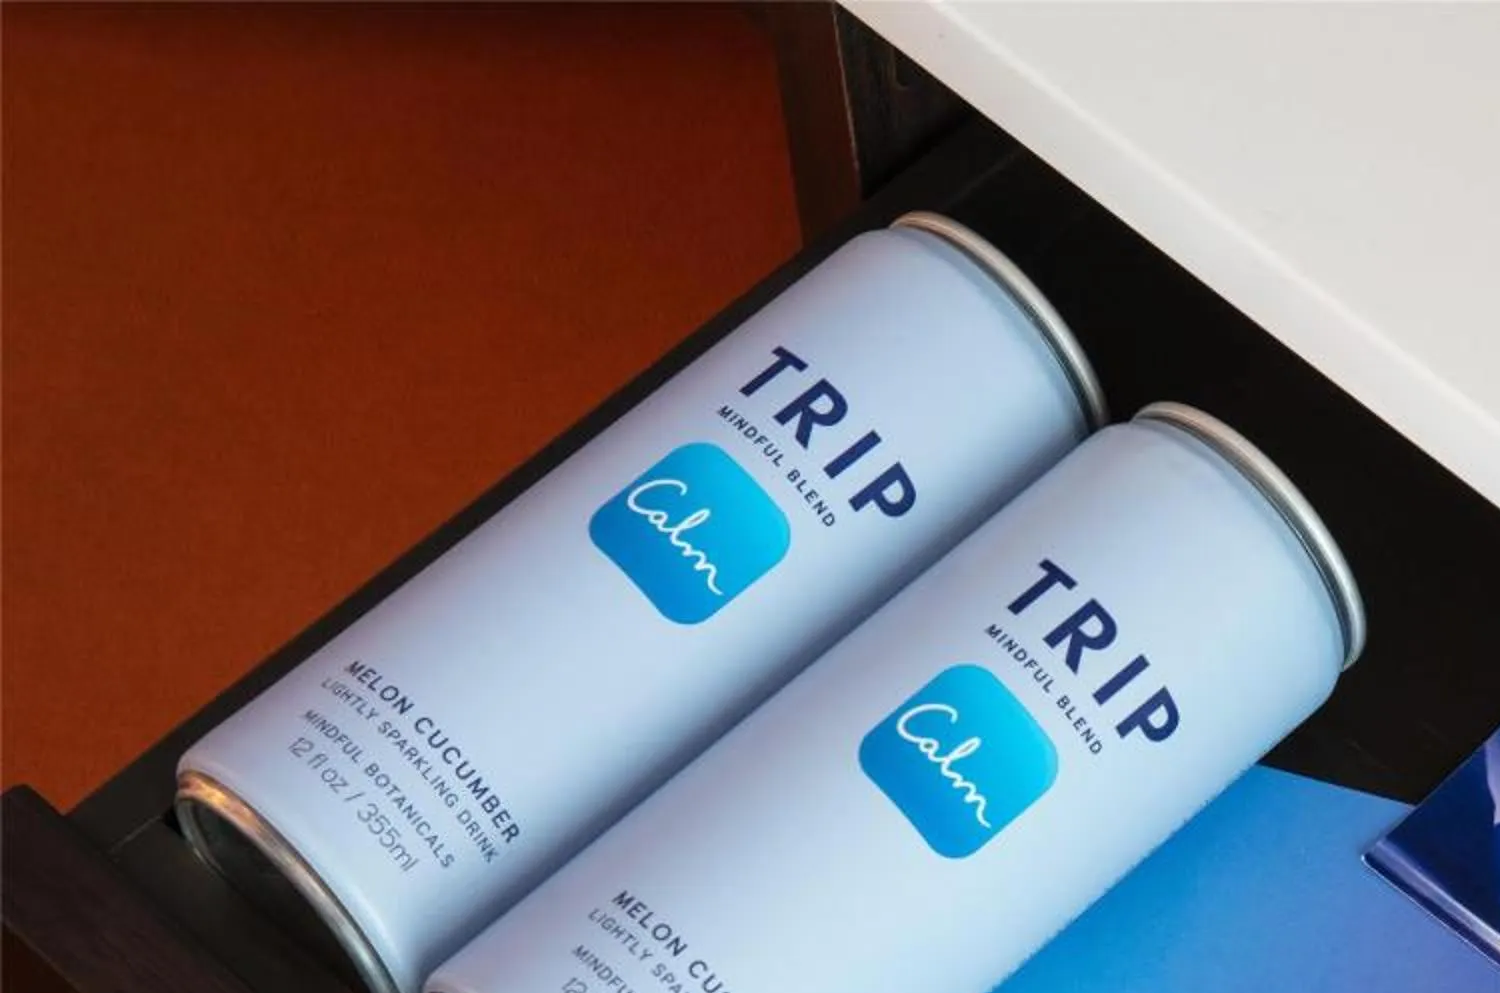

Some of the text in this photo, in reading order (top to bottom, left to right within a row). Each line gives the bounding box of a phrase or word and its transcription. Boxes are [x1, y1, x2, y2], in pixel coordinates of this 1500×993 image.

[716, 405, 836, 528] MINDFUL BLEND
[739, 345, 917, 518] TRIP
[627, 479, 724, 596] Calm
[984, 624, 1103, 755] MINDFUL BLEND
[1007, 558, 1180, 743] TRIP
[288, 737, 420, 873] 12 fl oz / 355ml
[303, 709, 455, 869] MINDFUL BOTANICALS
[321, 677, 499, 864] LIGHTLY SPARKLING DRINK
[345, 661, 520, 843] MELON CUCUMBER
[896, 703, 992, 829] Calm
[588, 907, 653, 962] LIGHTLY
[611, 890, 688, 957] MELON
